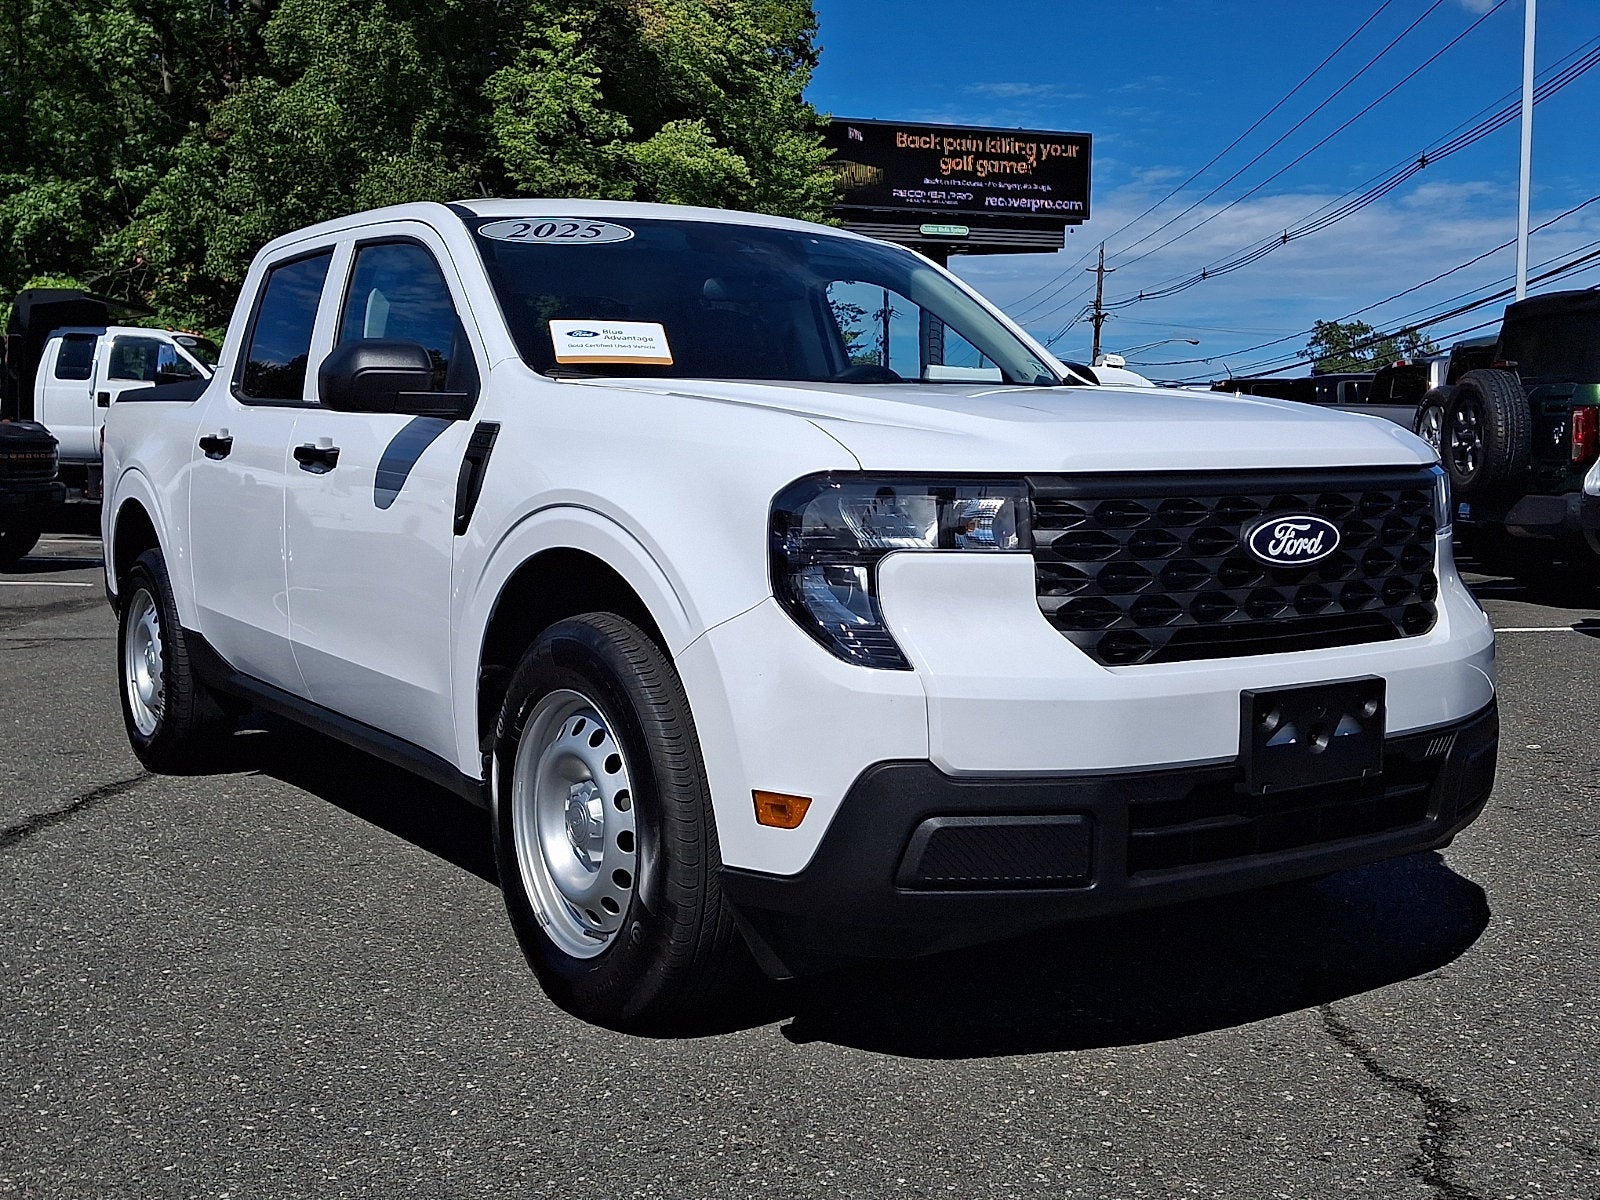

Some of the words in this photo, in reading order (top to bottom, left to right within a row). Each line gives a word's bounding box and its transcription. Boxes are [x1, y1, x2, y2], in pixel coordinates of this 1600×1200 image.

[896, 131, 941, 150] Back
[943, 134, 983, 155] pain
[985, 135, 1037, 158] killing
[1040, 142, 1080, 161] your
[940, 154, 975, 176] golf
[984, 195, 1083, 212] recoverpro.com
[507, 222, 605, 239] 2025
[603, 334, 654, 343] Advantage
[1268, 522, 1325, 556] Ford
